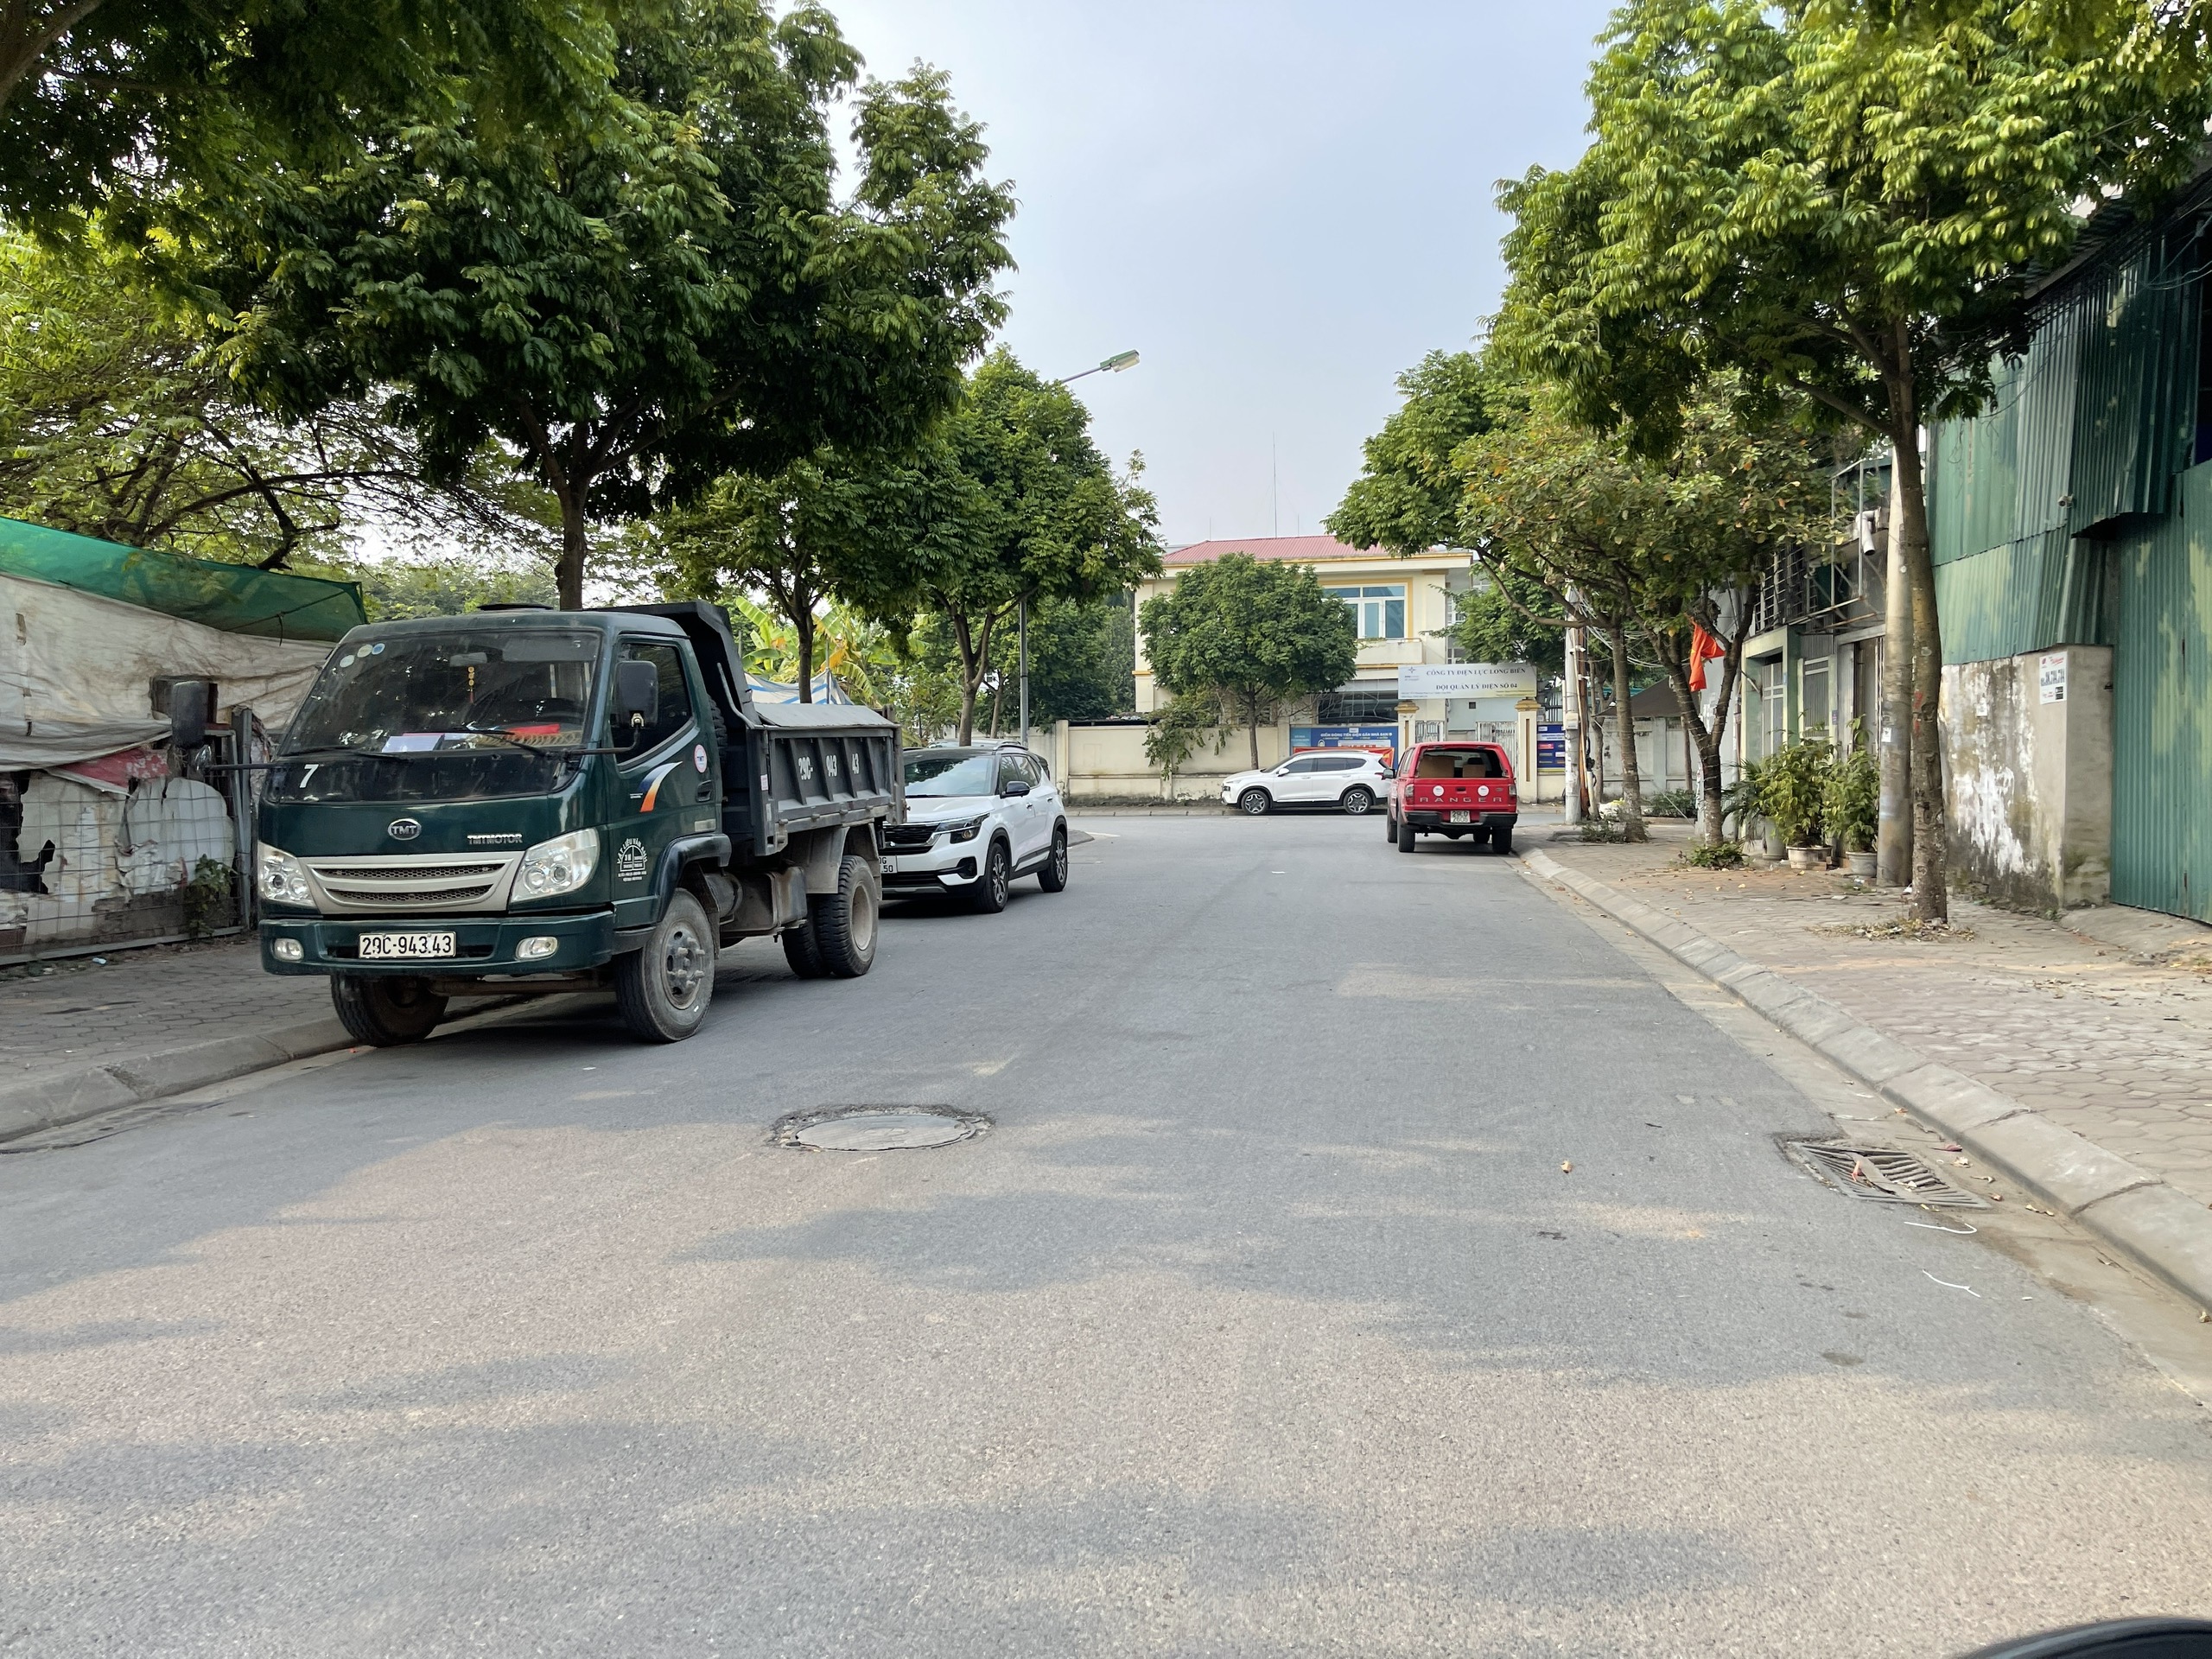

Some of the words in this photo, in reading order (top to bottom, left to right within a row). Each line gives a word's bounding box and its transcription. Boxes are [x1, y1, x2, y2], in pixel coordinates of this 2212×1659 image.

[299, 764, 320, 788] 7
[391, 825, 417, 835] TMT
[467, 833, 523, 845] TMTMOTOR
